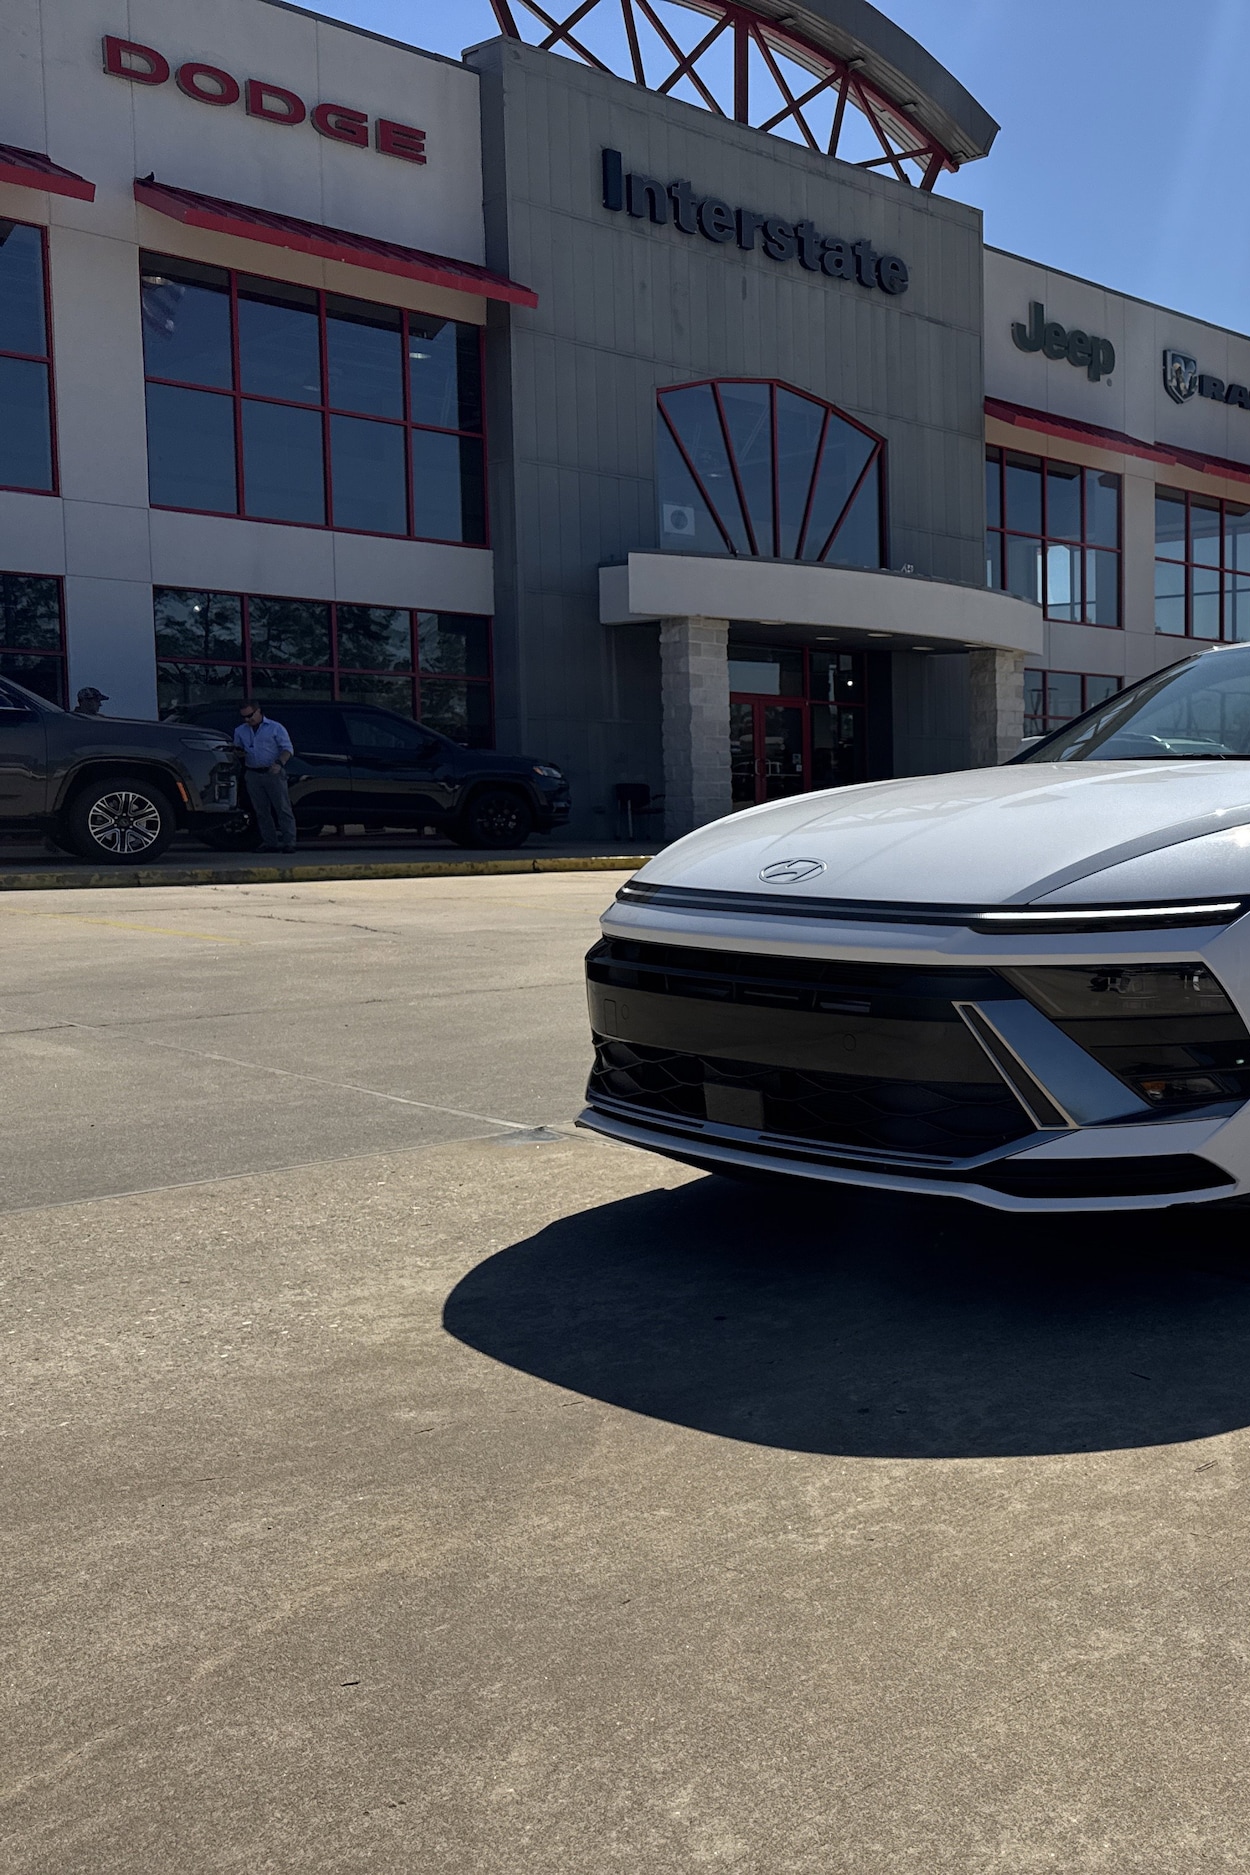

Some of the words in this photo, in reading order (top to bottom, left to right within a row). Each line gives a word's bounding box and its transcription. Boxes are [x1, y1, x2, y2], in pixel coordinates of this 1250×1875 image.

[102, 34, 427, 165] DODGE
[602, 148, 909, 295] Interstate
[1011, 301, 1116, 382] Jeep
